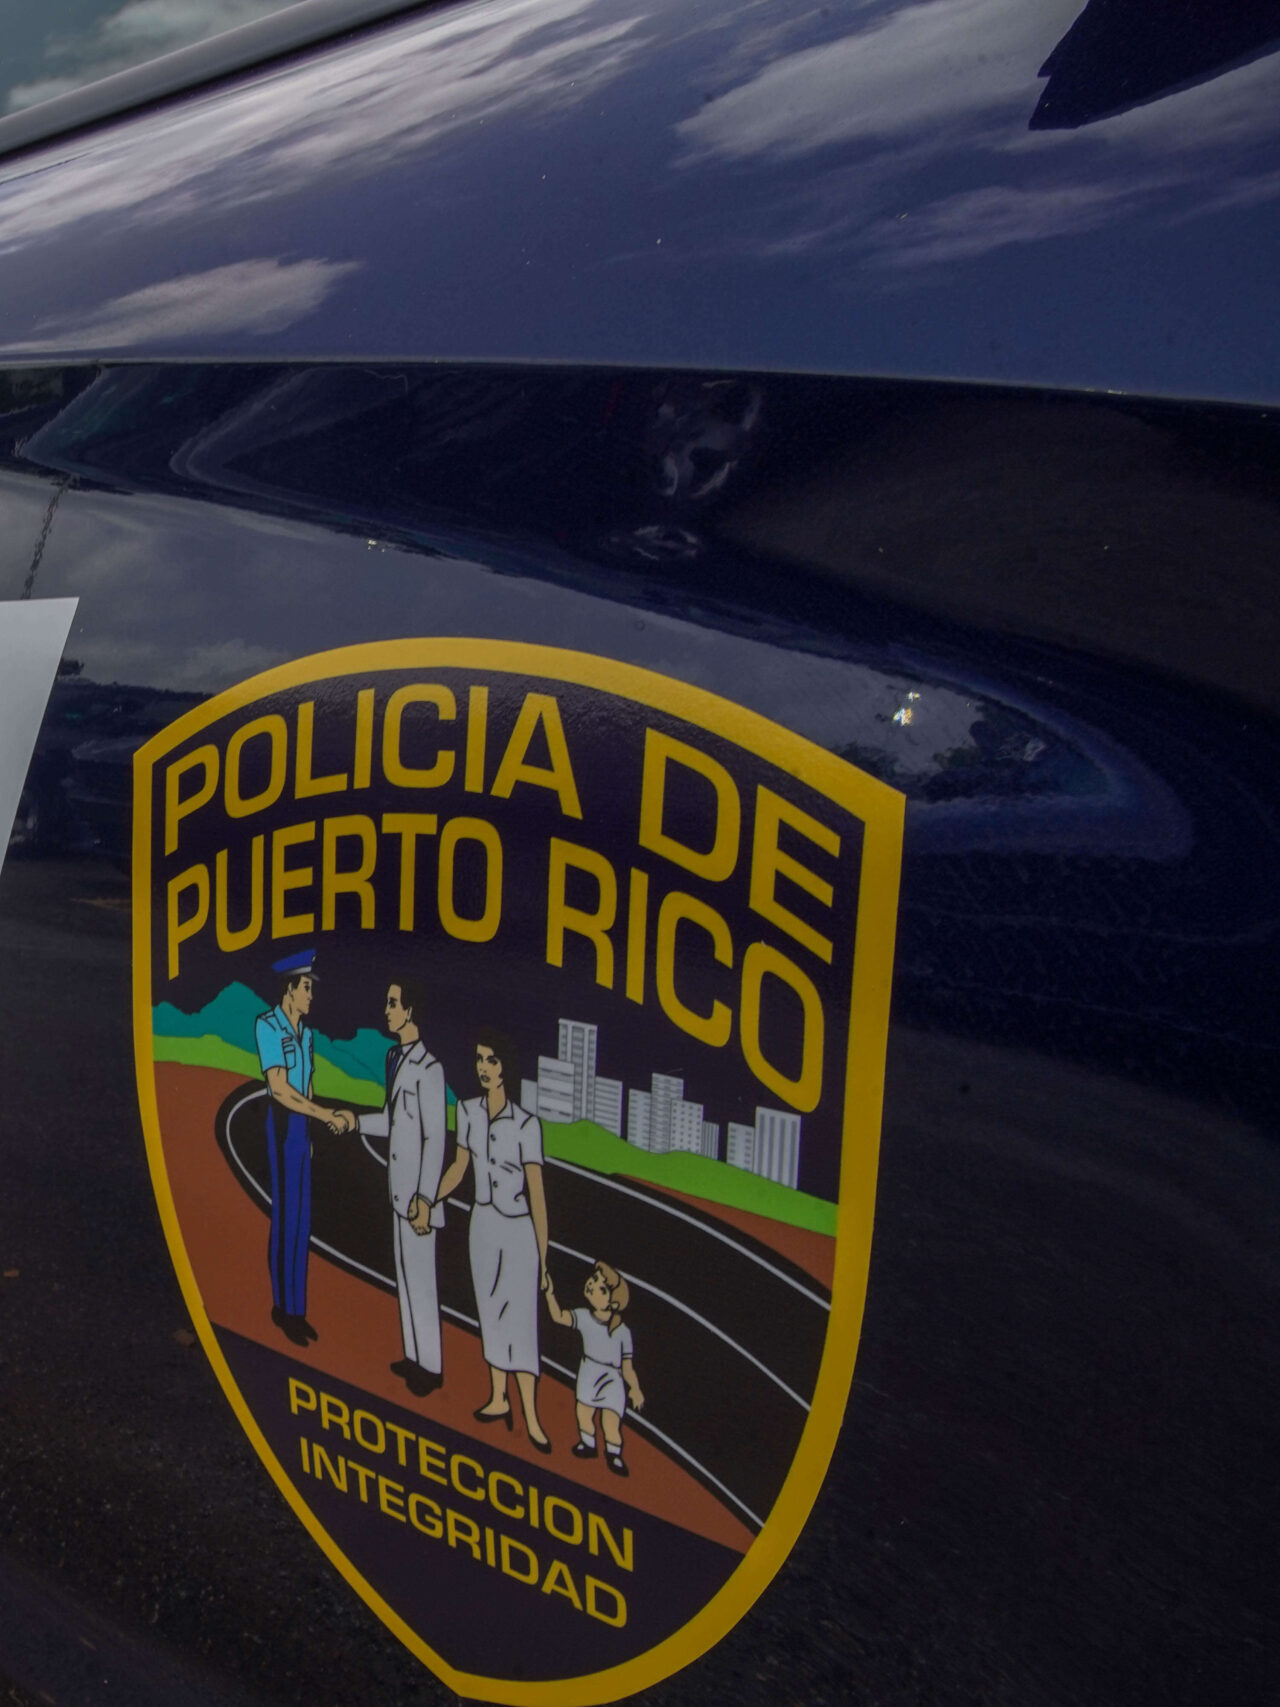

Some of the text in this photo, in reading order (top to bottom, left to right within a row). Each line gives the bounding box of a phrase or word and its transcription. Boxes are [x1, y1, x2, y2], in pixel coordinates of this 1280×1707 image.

[166, 684, 841, 964] POLICIA DE
[167, 813, 825, 1113] PUERTO RICO
[288, 1377, 634, 1572] PROTECCION
[300, 1437, 628, 1629] INTEGRIDAD
